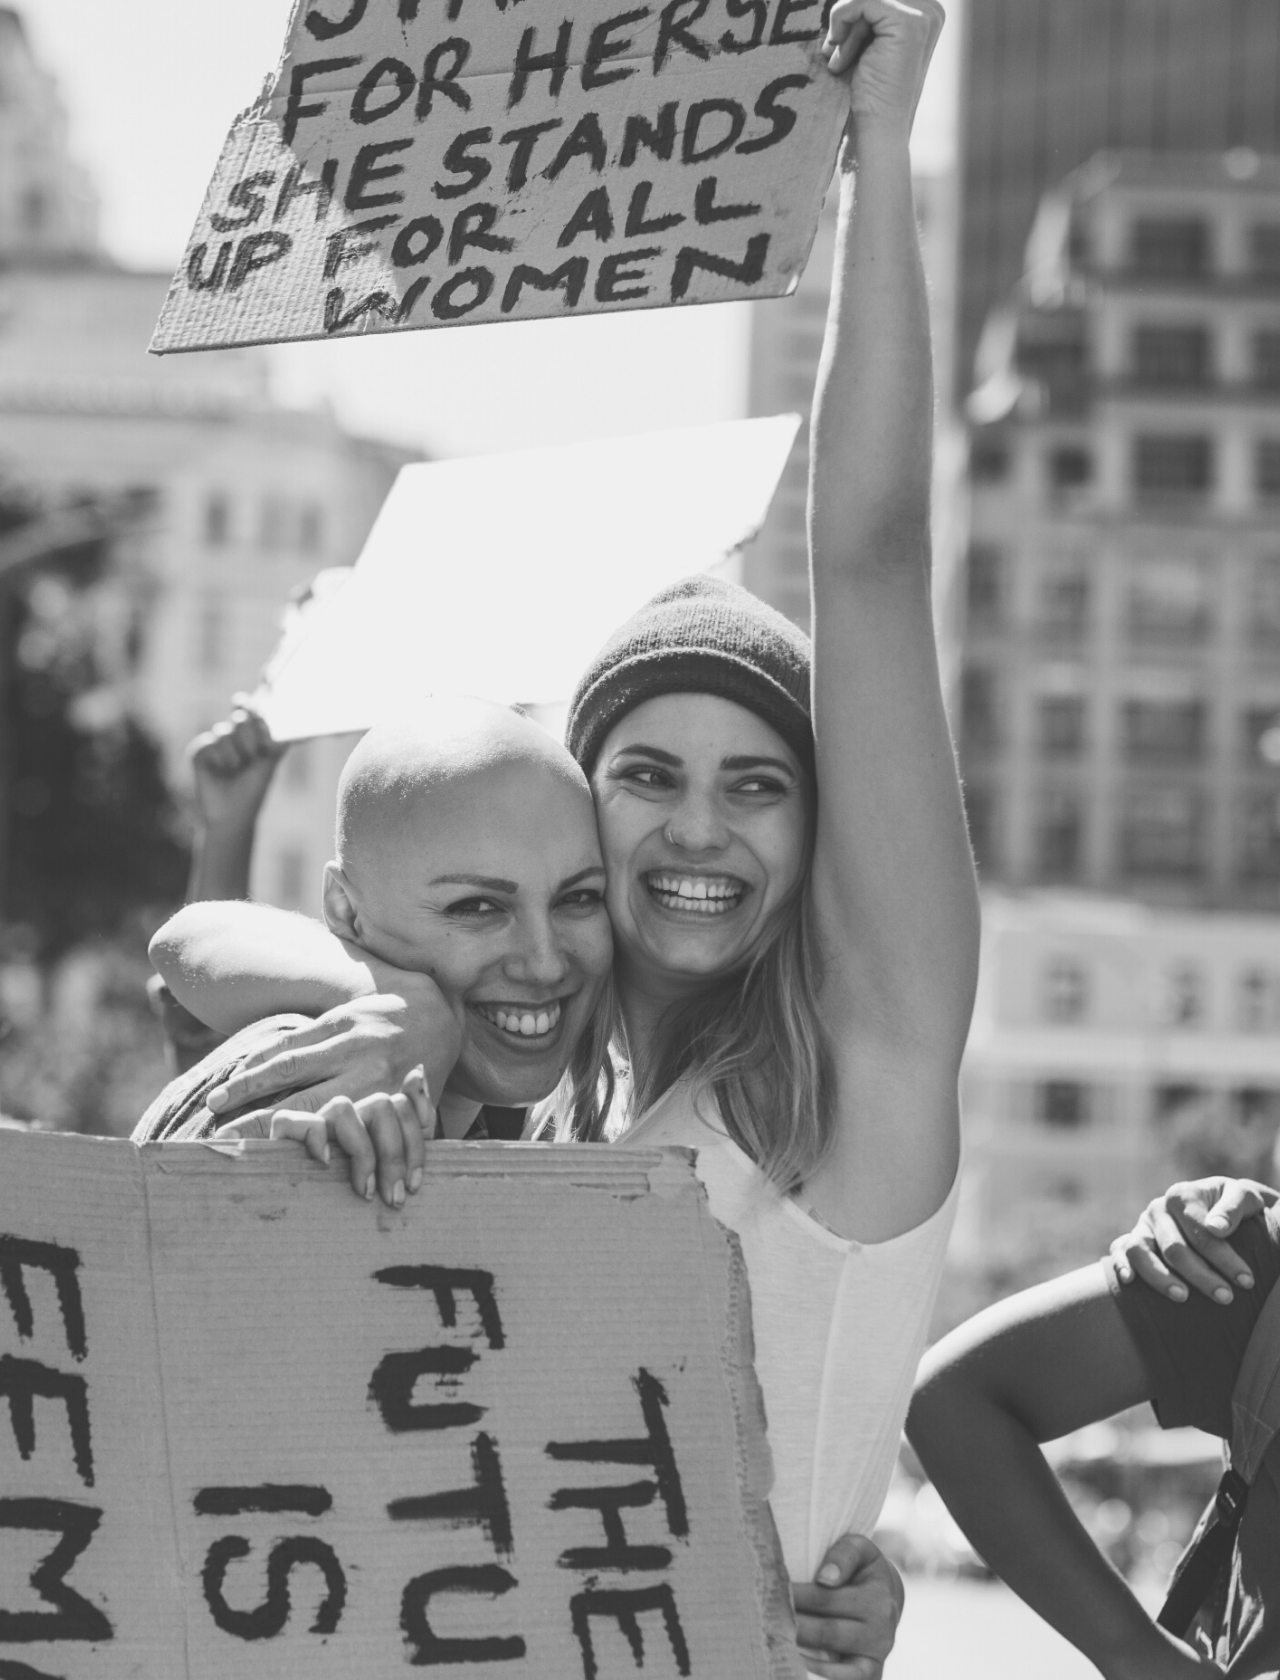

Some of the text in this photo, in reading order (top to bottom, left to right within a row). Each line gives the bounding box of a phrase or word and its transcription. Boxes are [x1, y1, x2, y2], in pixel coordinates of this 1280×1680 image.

[211, 73, 814, 233] SHE STANDS
[283, 36, 472, 147] FOR
[187, 176, 761, 294] UP FOR ALL
[322, 233, 773, 333] WOMEN
[368, 1263, 528, 1666] FUTU
[543, 1366, 691, 1680] THE
[192, 1482, 347, 1641] IS
